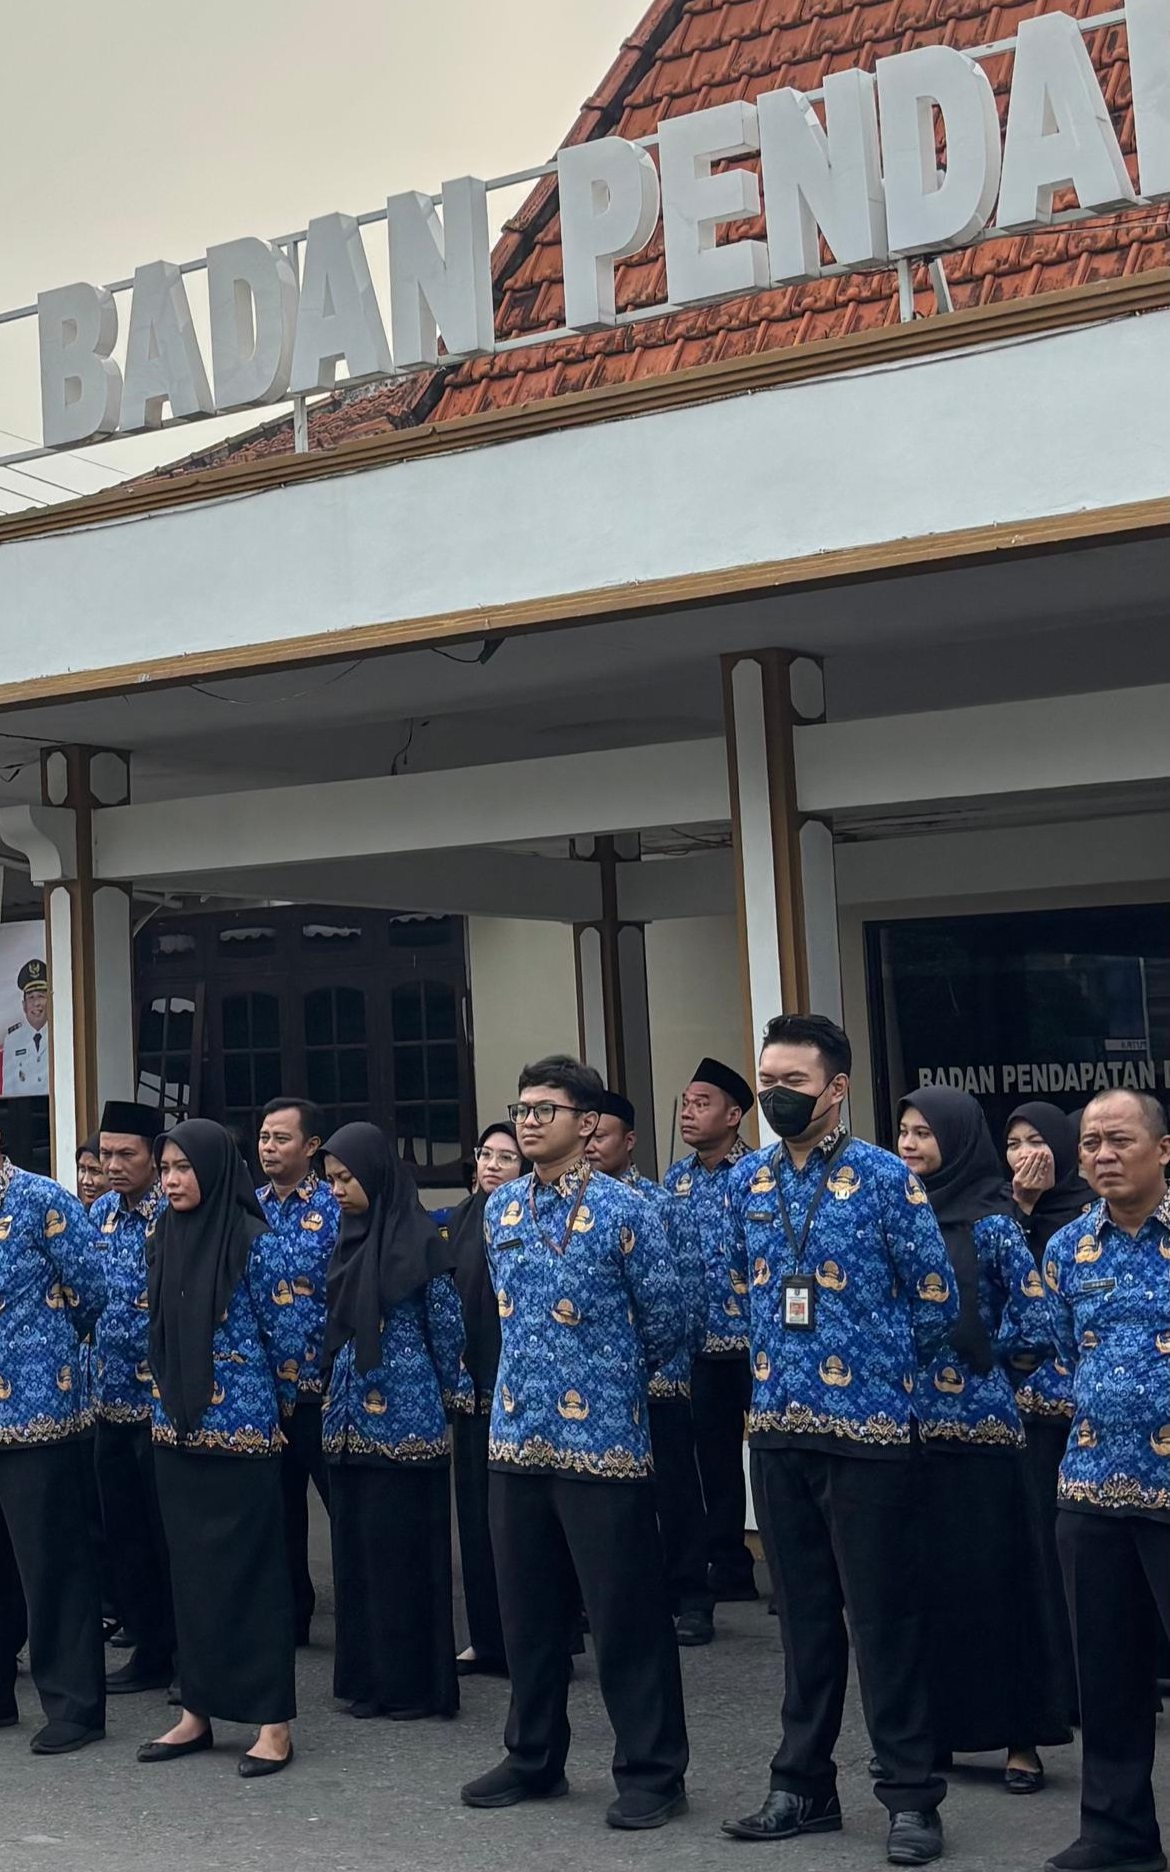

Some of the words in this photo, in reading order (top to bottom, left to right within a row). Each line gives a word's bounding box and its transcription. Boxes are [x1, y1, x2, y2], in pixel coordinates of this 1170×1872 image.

[38, 176, 494, 448] BADAN
[918, 1065, 996, 1094] BADAN
[1002, 1060, 1156, 1093] PENDAPATAN
